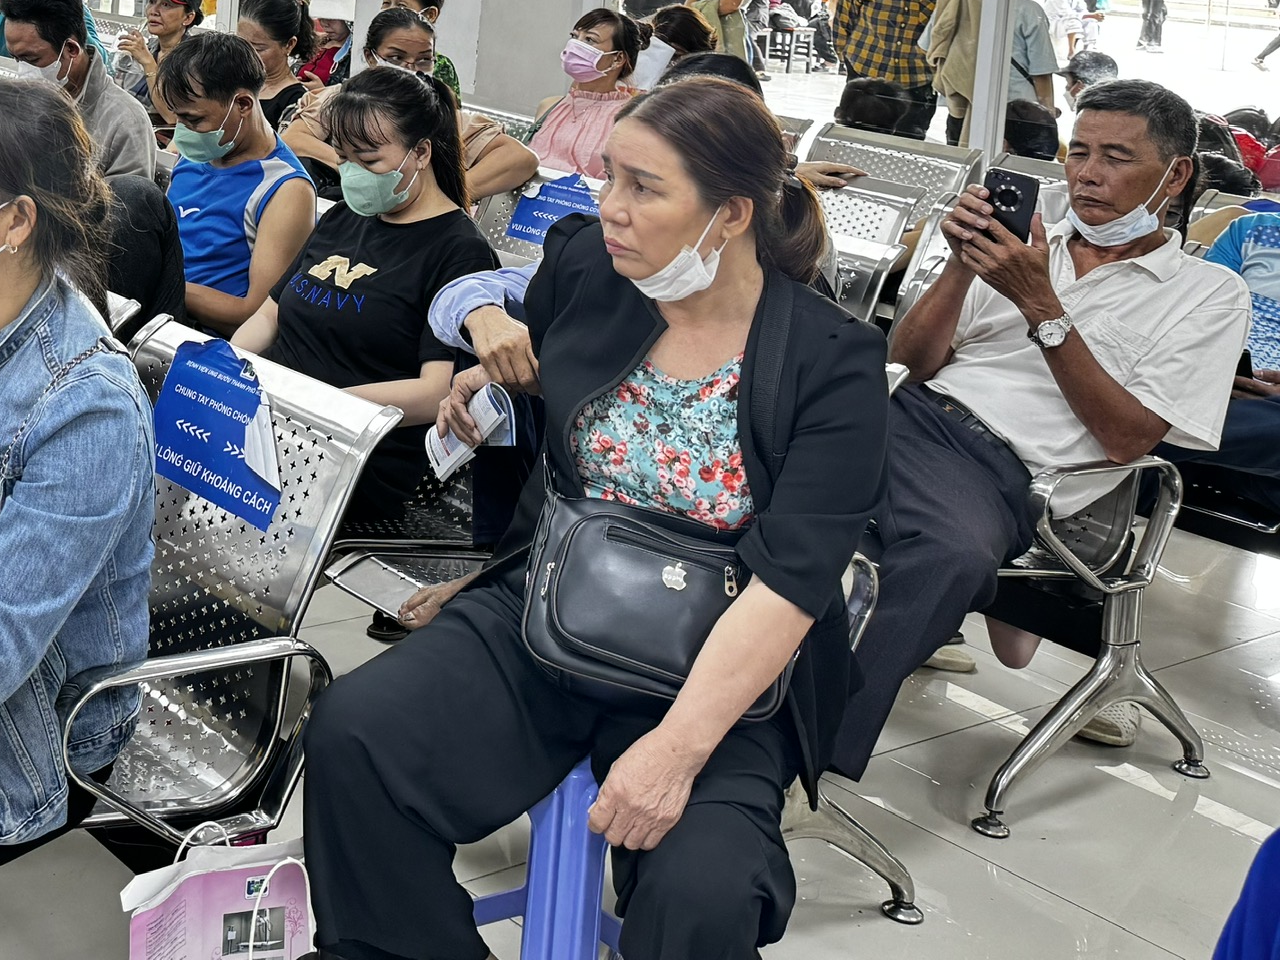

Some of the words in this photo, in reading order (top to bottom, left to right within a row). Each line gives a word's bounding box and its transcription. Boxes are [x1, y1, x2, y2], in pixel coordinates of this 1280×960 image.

[511, 223, 522, 231] VUI
[523, 224, 541, 236] LÒNG
[208, 369, 219, 378] UNG
[174, 383, 197, 400] CHUNG
[197, 392, 210, 406] TAY
[209, 399, 232, 417] PHÒNG
[232, 406, 253, 426] CHỐN
[157, 443, 184, 467] LÒNG
[183, 458, 202, 476] GIỮ
[201, 467, 243, 500] KHOẢNG
[242, 487, 272, 514] CÁCH
